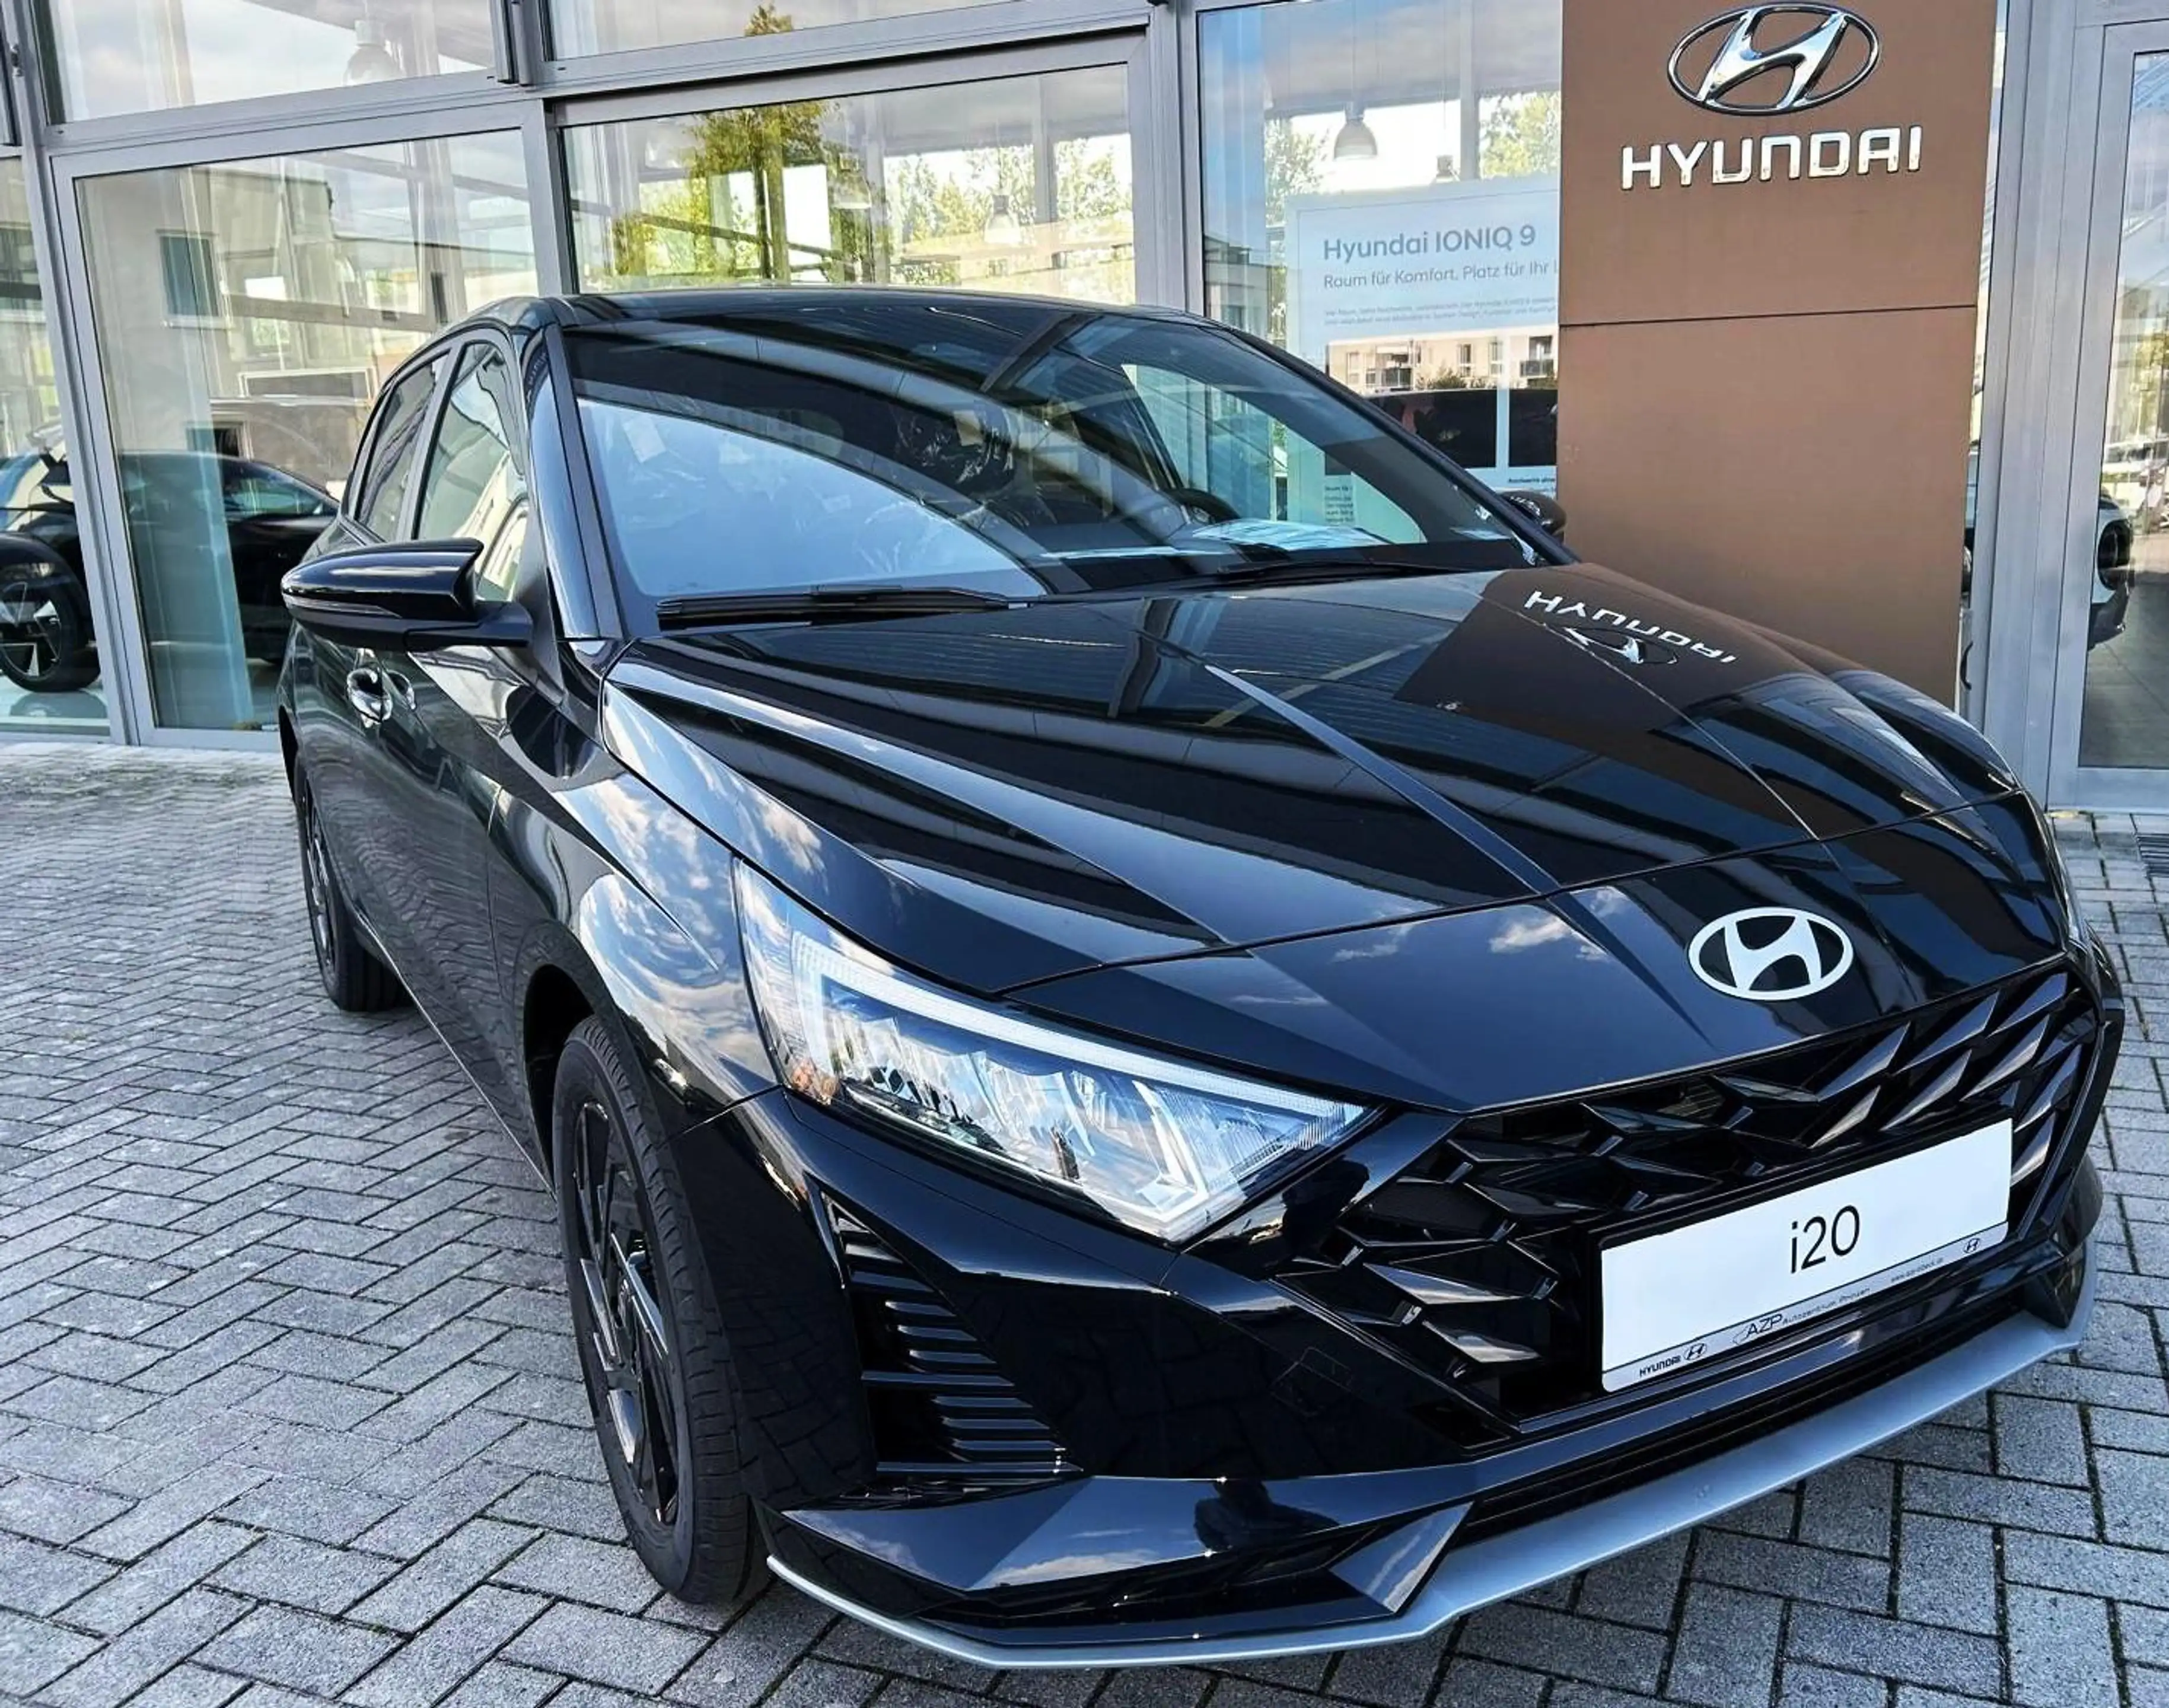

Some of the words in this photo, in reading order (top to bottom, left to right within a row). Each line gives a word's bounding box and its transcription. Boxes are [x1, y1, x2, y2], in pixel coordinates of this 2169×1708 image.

[1621, 125, 1922, 190] HYUNDAI
[1323, 231, 1428, 263] Hyundai
[1435, 226, 1512, 253] IONIQ
[1520, 224, 1537, 247] 9
[1323, 273, 1367, 288] Raum
[1371, 270, 1391, 286] für
[1463, 265, 1500, 280] Platz
[1504, 262, 1525, 276] für
[1530, 260, 1549, 275] Ihr
[1791, 1204, 1860, 1274] i20
[1745, 1314, 1783, 1337] AZP
[1639, 1355, 1681, 1376] HYUNDAI
